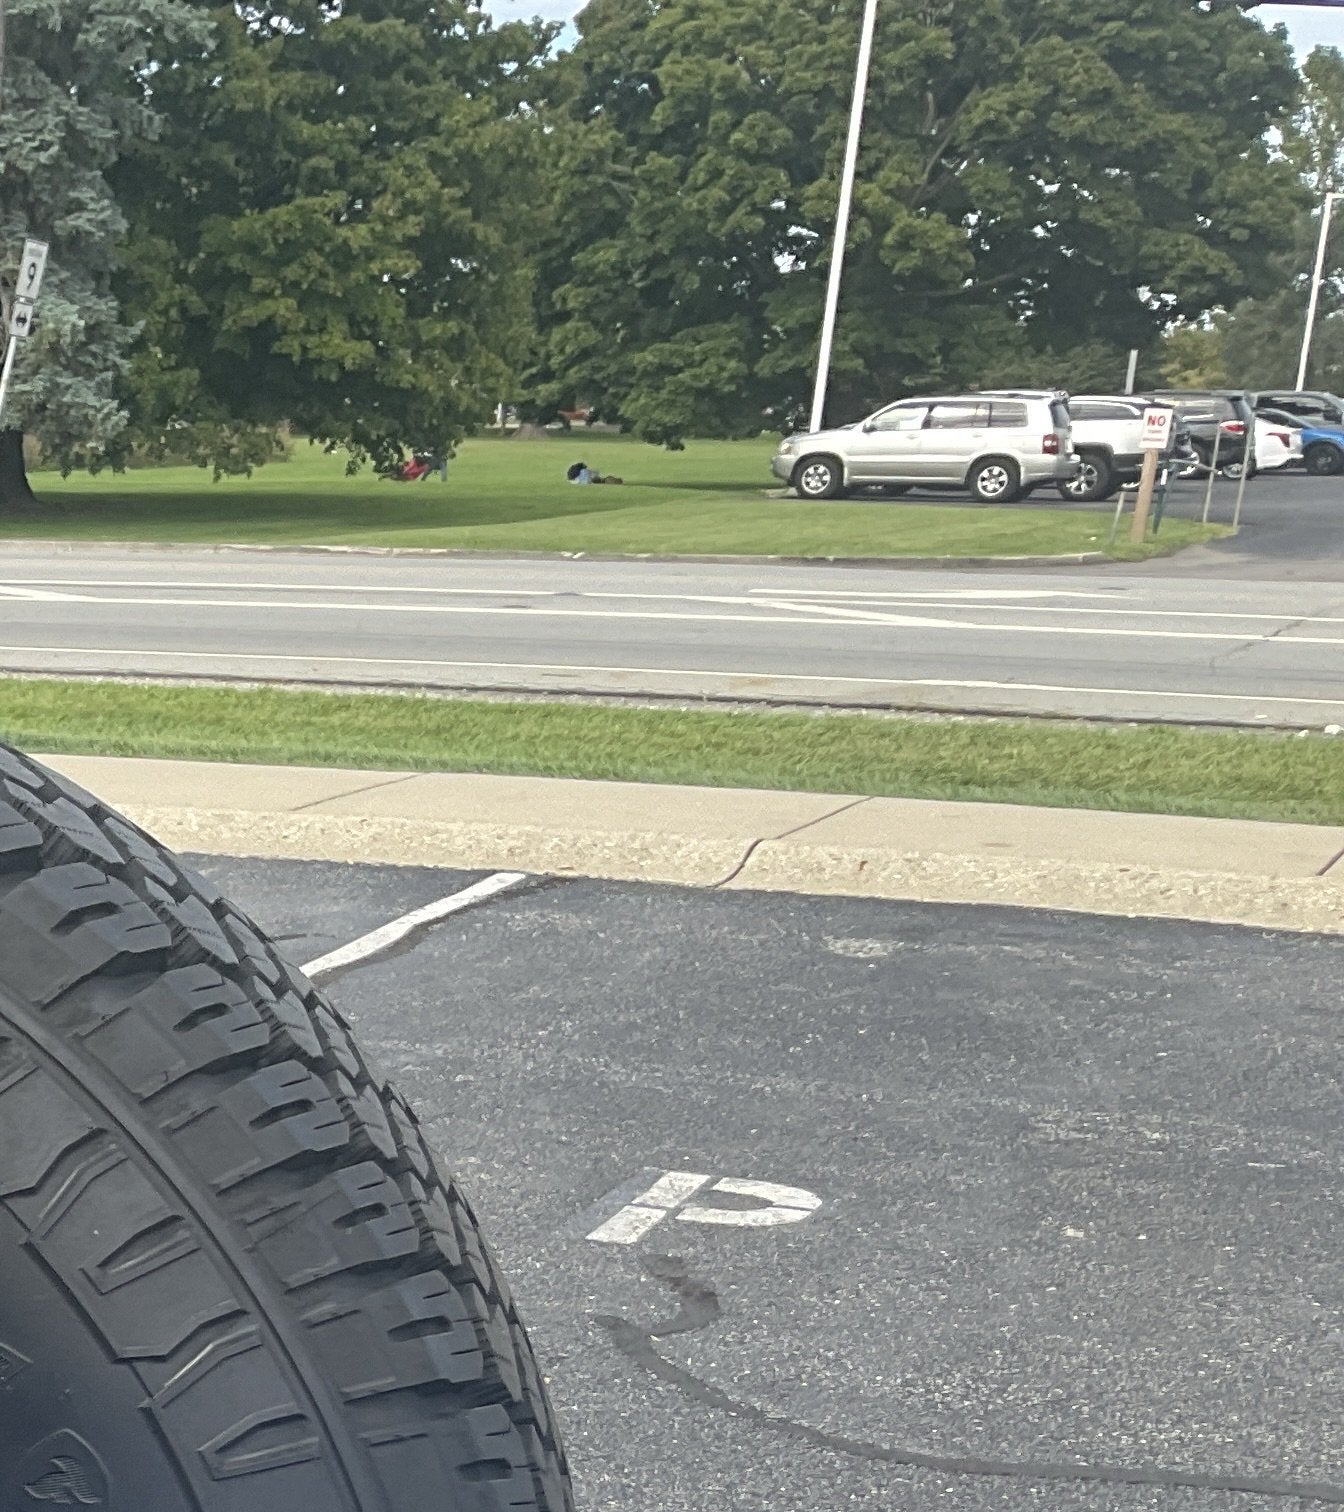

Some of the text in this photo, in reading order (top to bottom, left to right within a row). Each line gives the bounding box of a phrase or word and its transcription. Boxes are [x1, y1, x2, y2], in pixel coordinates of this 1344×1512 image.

[27, 262, 36, 290] 9
[1147, 415, 1166, 426] NO
[584, 1170, 824, 1244] P
